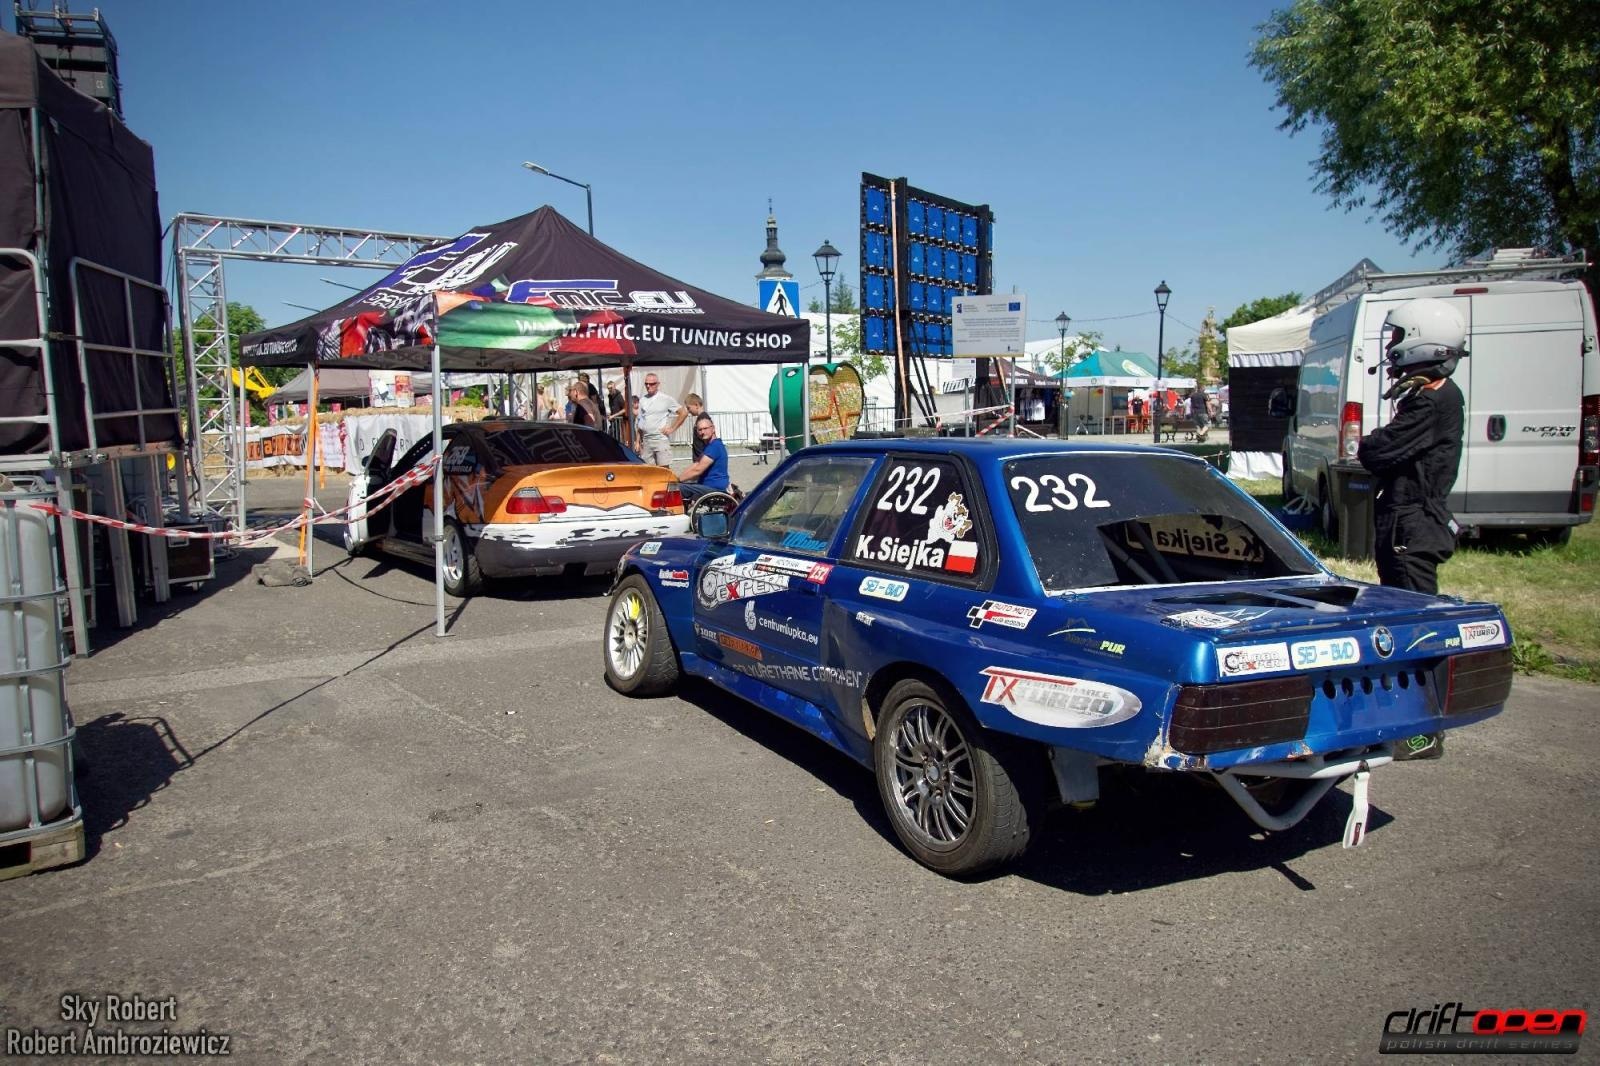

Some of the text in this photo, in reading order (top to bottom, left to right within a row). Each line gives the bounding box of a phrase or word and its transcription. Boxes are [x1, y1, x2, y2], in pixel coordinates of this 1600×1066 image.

[669, 327, 741, 347] TUNING
[745, 333, 792, 349] SHOP
[877, 465, 941, 515] 232
[1010, 473, 1111, 512] 232
[855, 534, 945, 571] K.Siejka
[1013, 608, 1034, 617] MOTO
[1100, 640, 1126, 655] PUR
